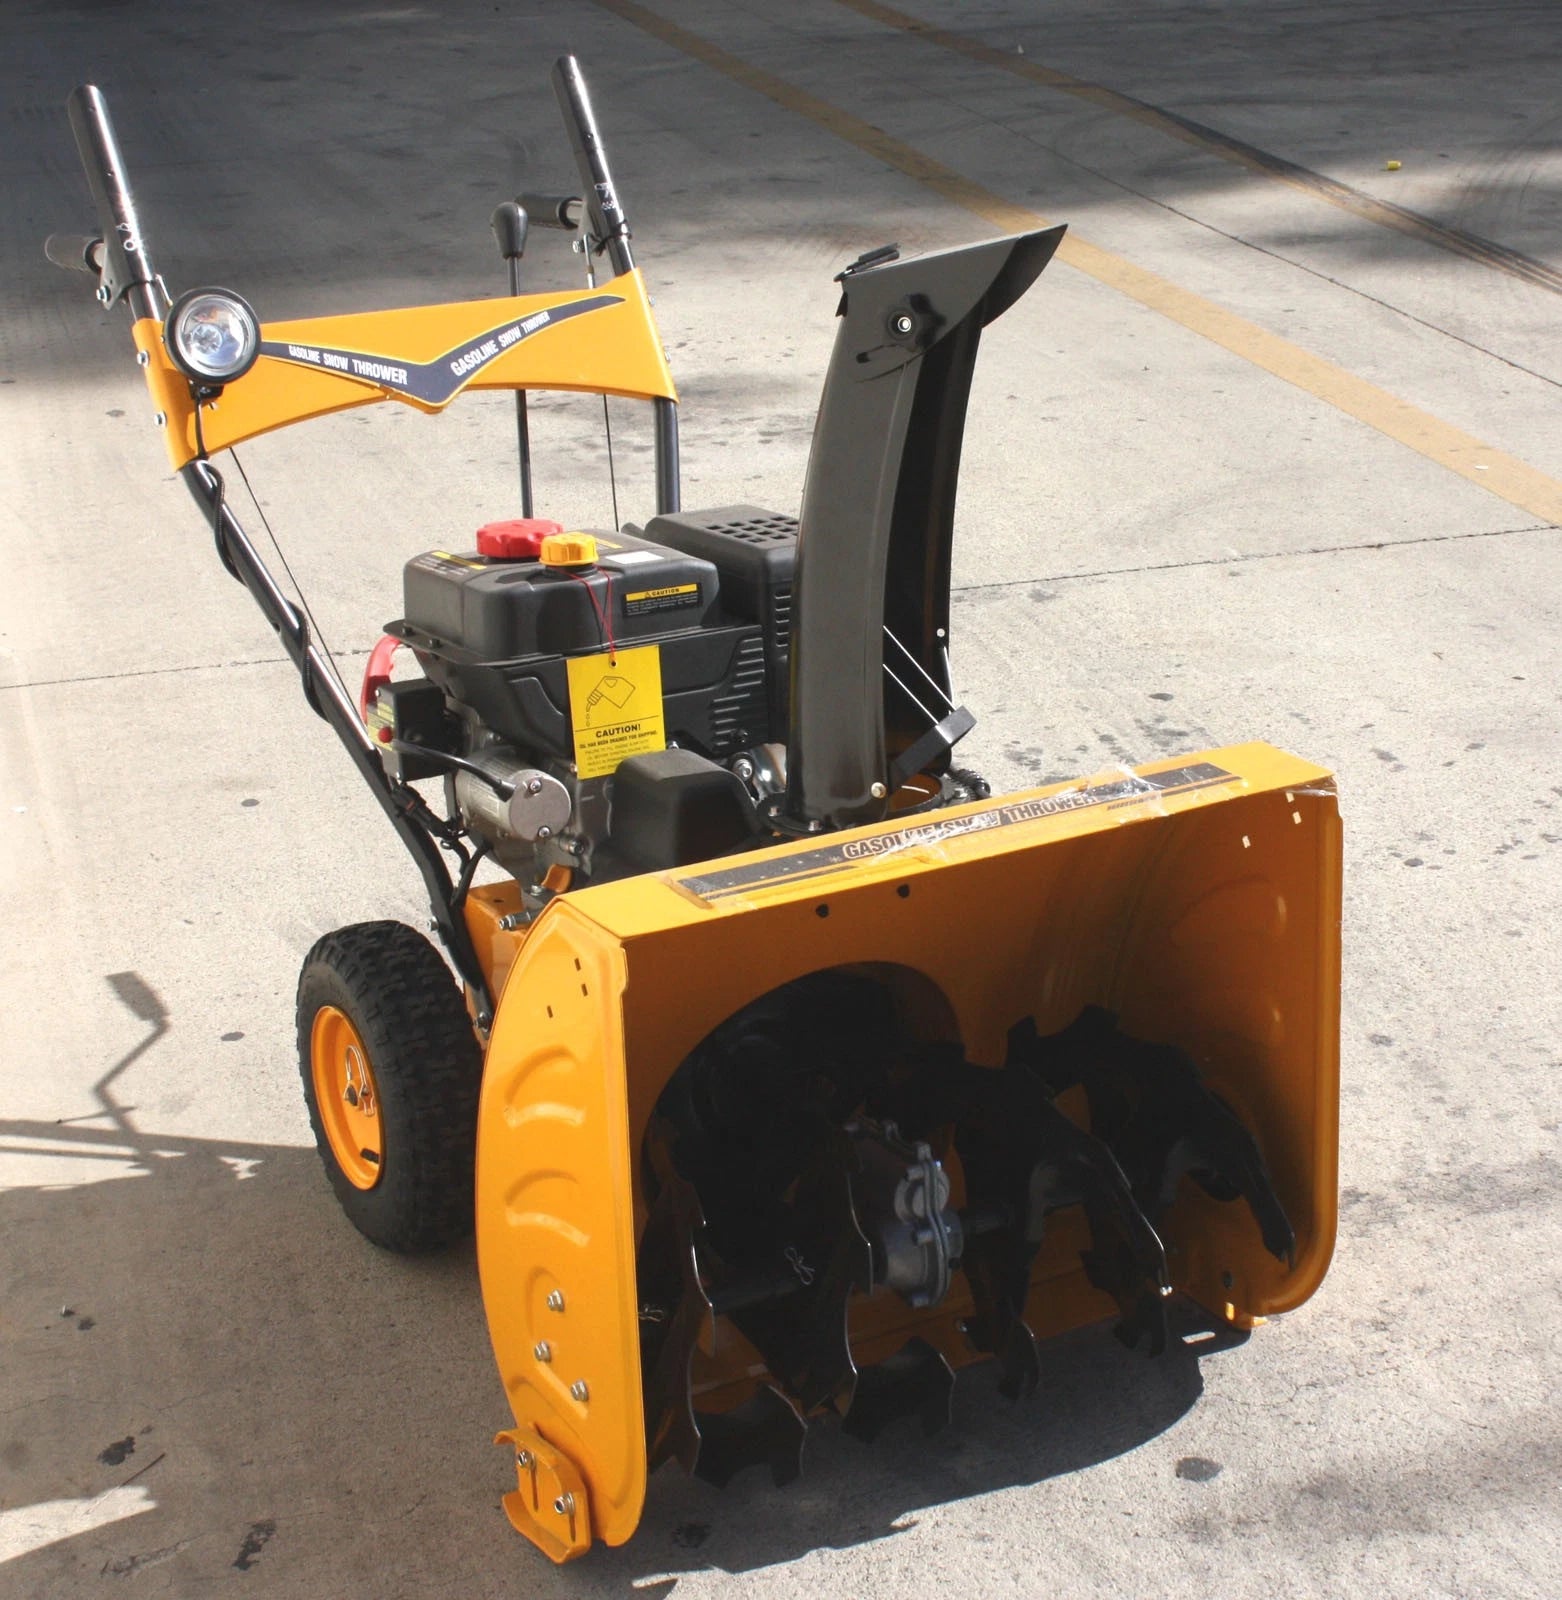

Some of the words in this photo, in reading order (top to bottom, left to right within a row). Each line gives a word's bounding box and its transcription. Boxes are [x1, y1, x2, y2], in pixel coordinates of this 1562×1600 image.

[450, 339, 499, 376] GASOLINE
[498, 325, 522, 348] SNOW
[521, 310, 550, 334] THROWER
[288, 344, 321, 364] GASOLINE
[323, 352, 349, 371] SNOW
[352, 358, 408, 385] THROWER
[651, 588, 680, 596] CAUTION
[595, 723, 641, 738] CAUTION!
[1006, 793, 1097, 821] THROWER
